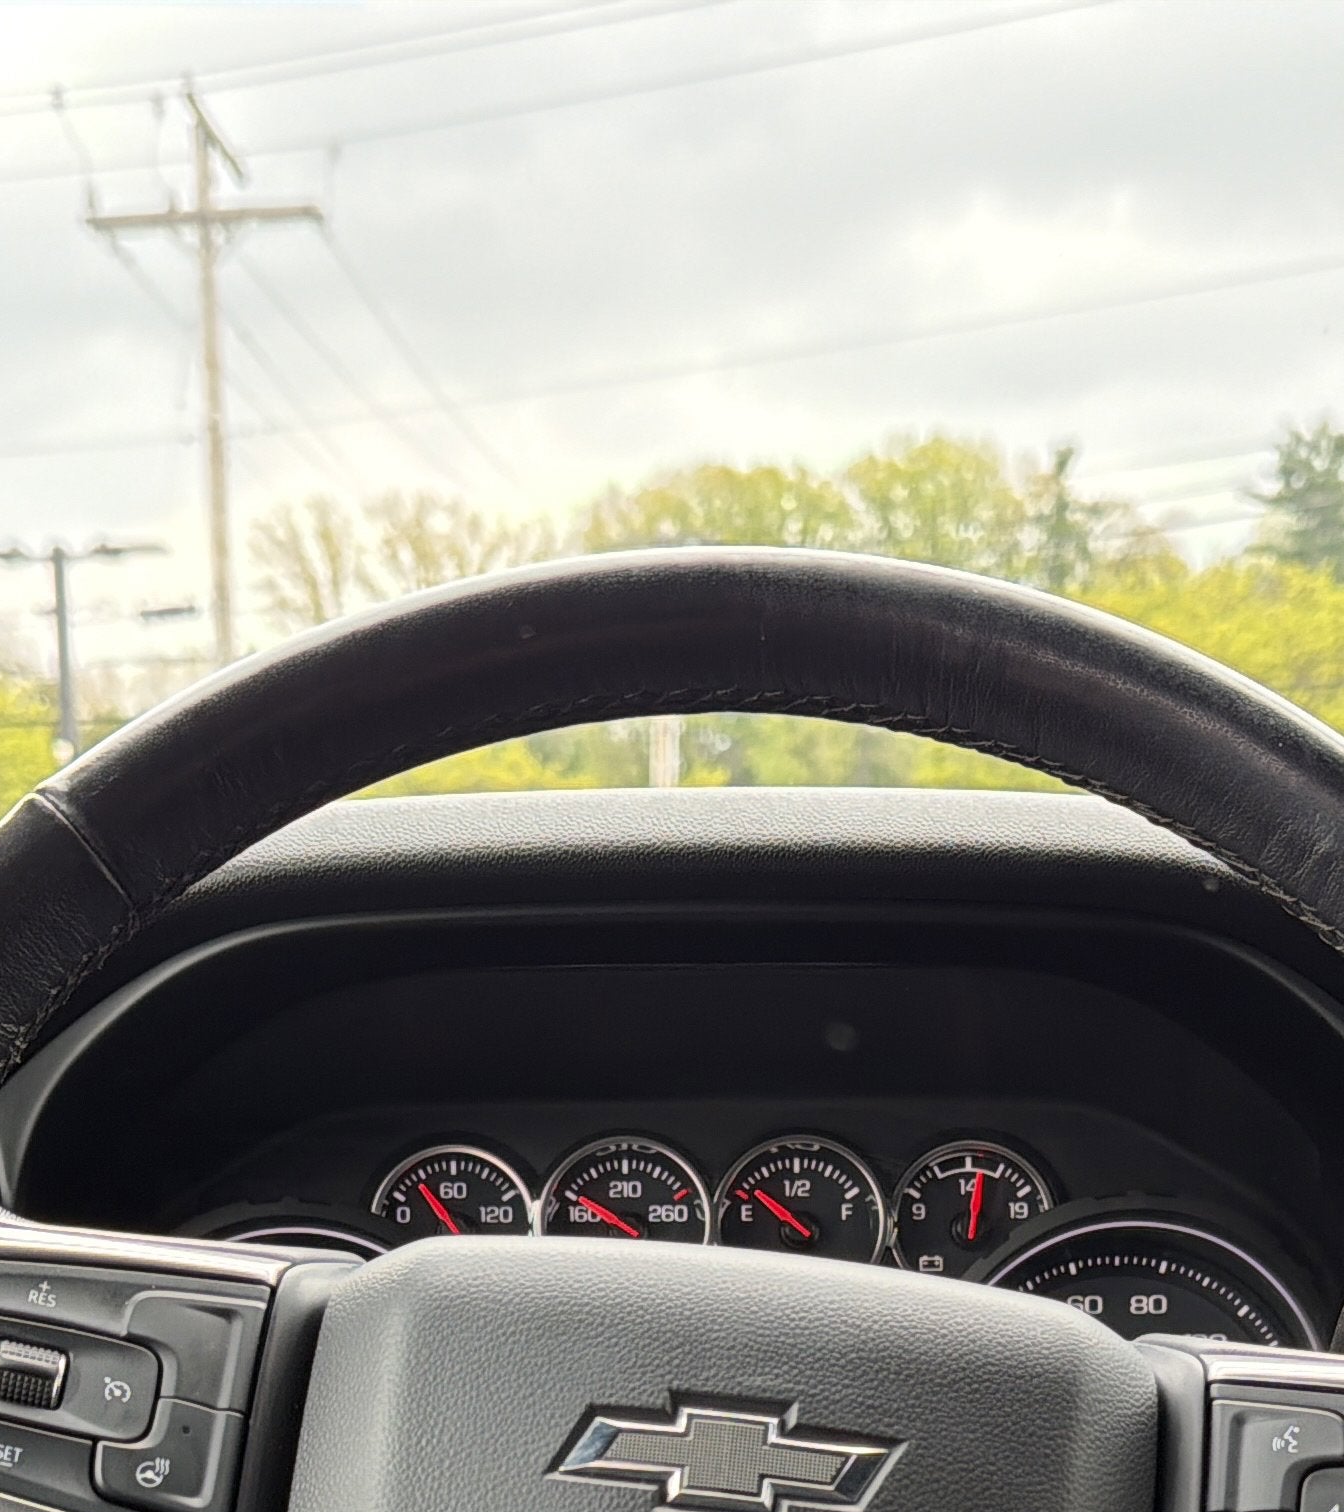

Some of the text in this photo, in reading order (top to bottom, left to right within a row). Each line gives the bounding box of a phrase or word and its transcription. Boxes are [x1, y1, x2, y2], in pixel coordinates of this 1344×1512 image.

[439, 1182, 468, 1200] 60
[608, 1180, 643, 1199] 210
[783, 1179, 811, 1198] 1/2
[479, 1205, 514, 1224] 120
[568, 1205, 602, 1223] 160
[647, 1204, 689, 1223] 260
[740, 1204, 754, 1222] E
[840, 1203, 854, 1221] F
[911, 1203, 927, 1221] 9
[1008, 1201, 1029, 1219] 19
[27, 1288, 57, 1308] RES
[1128, 1294, 1169, 1315] 80
